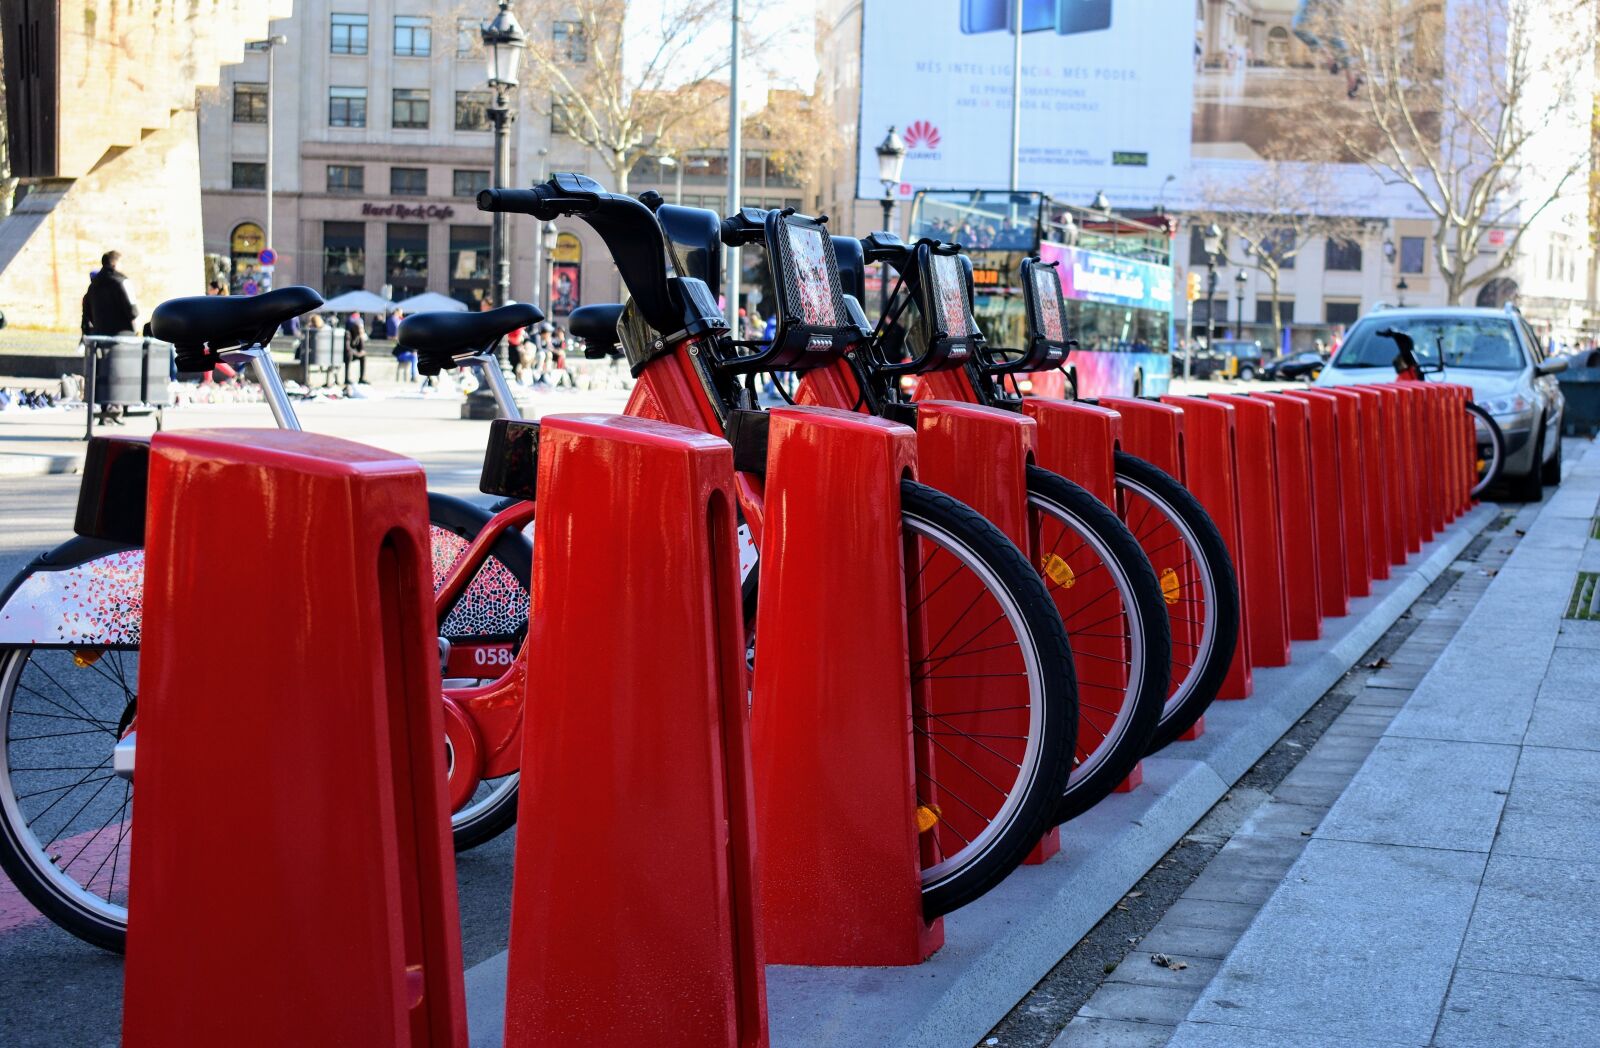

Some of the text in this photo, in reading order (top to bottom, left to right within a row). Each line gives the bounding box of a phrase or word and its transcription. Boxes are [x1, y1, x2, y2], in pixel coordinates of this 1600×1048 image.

[362, 203, 455, 220] Hard Rock Cafe
